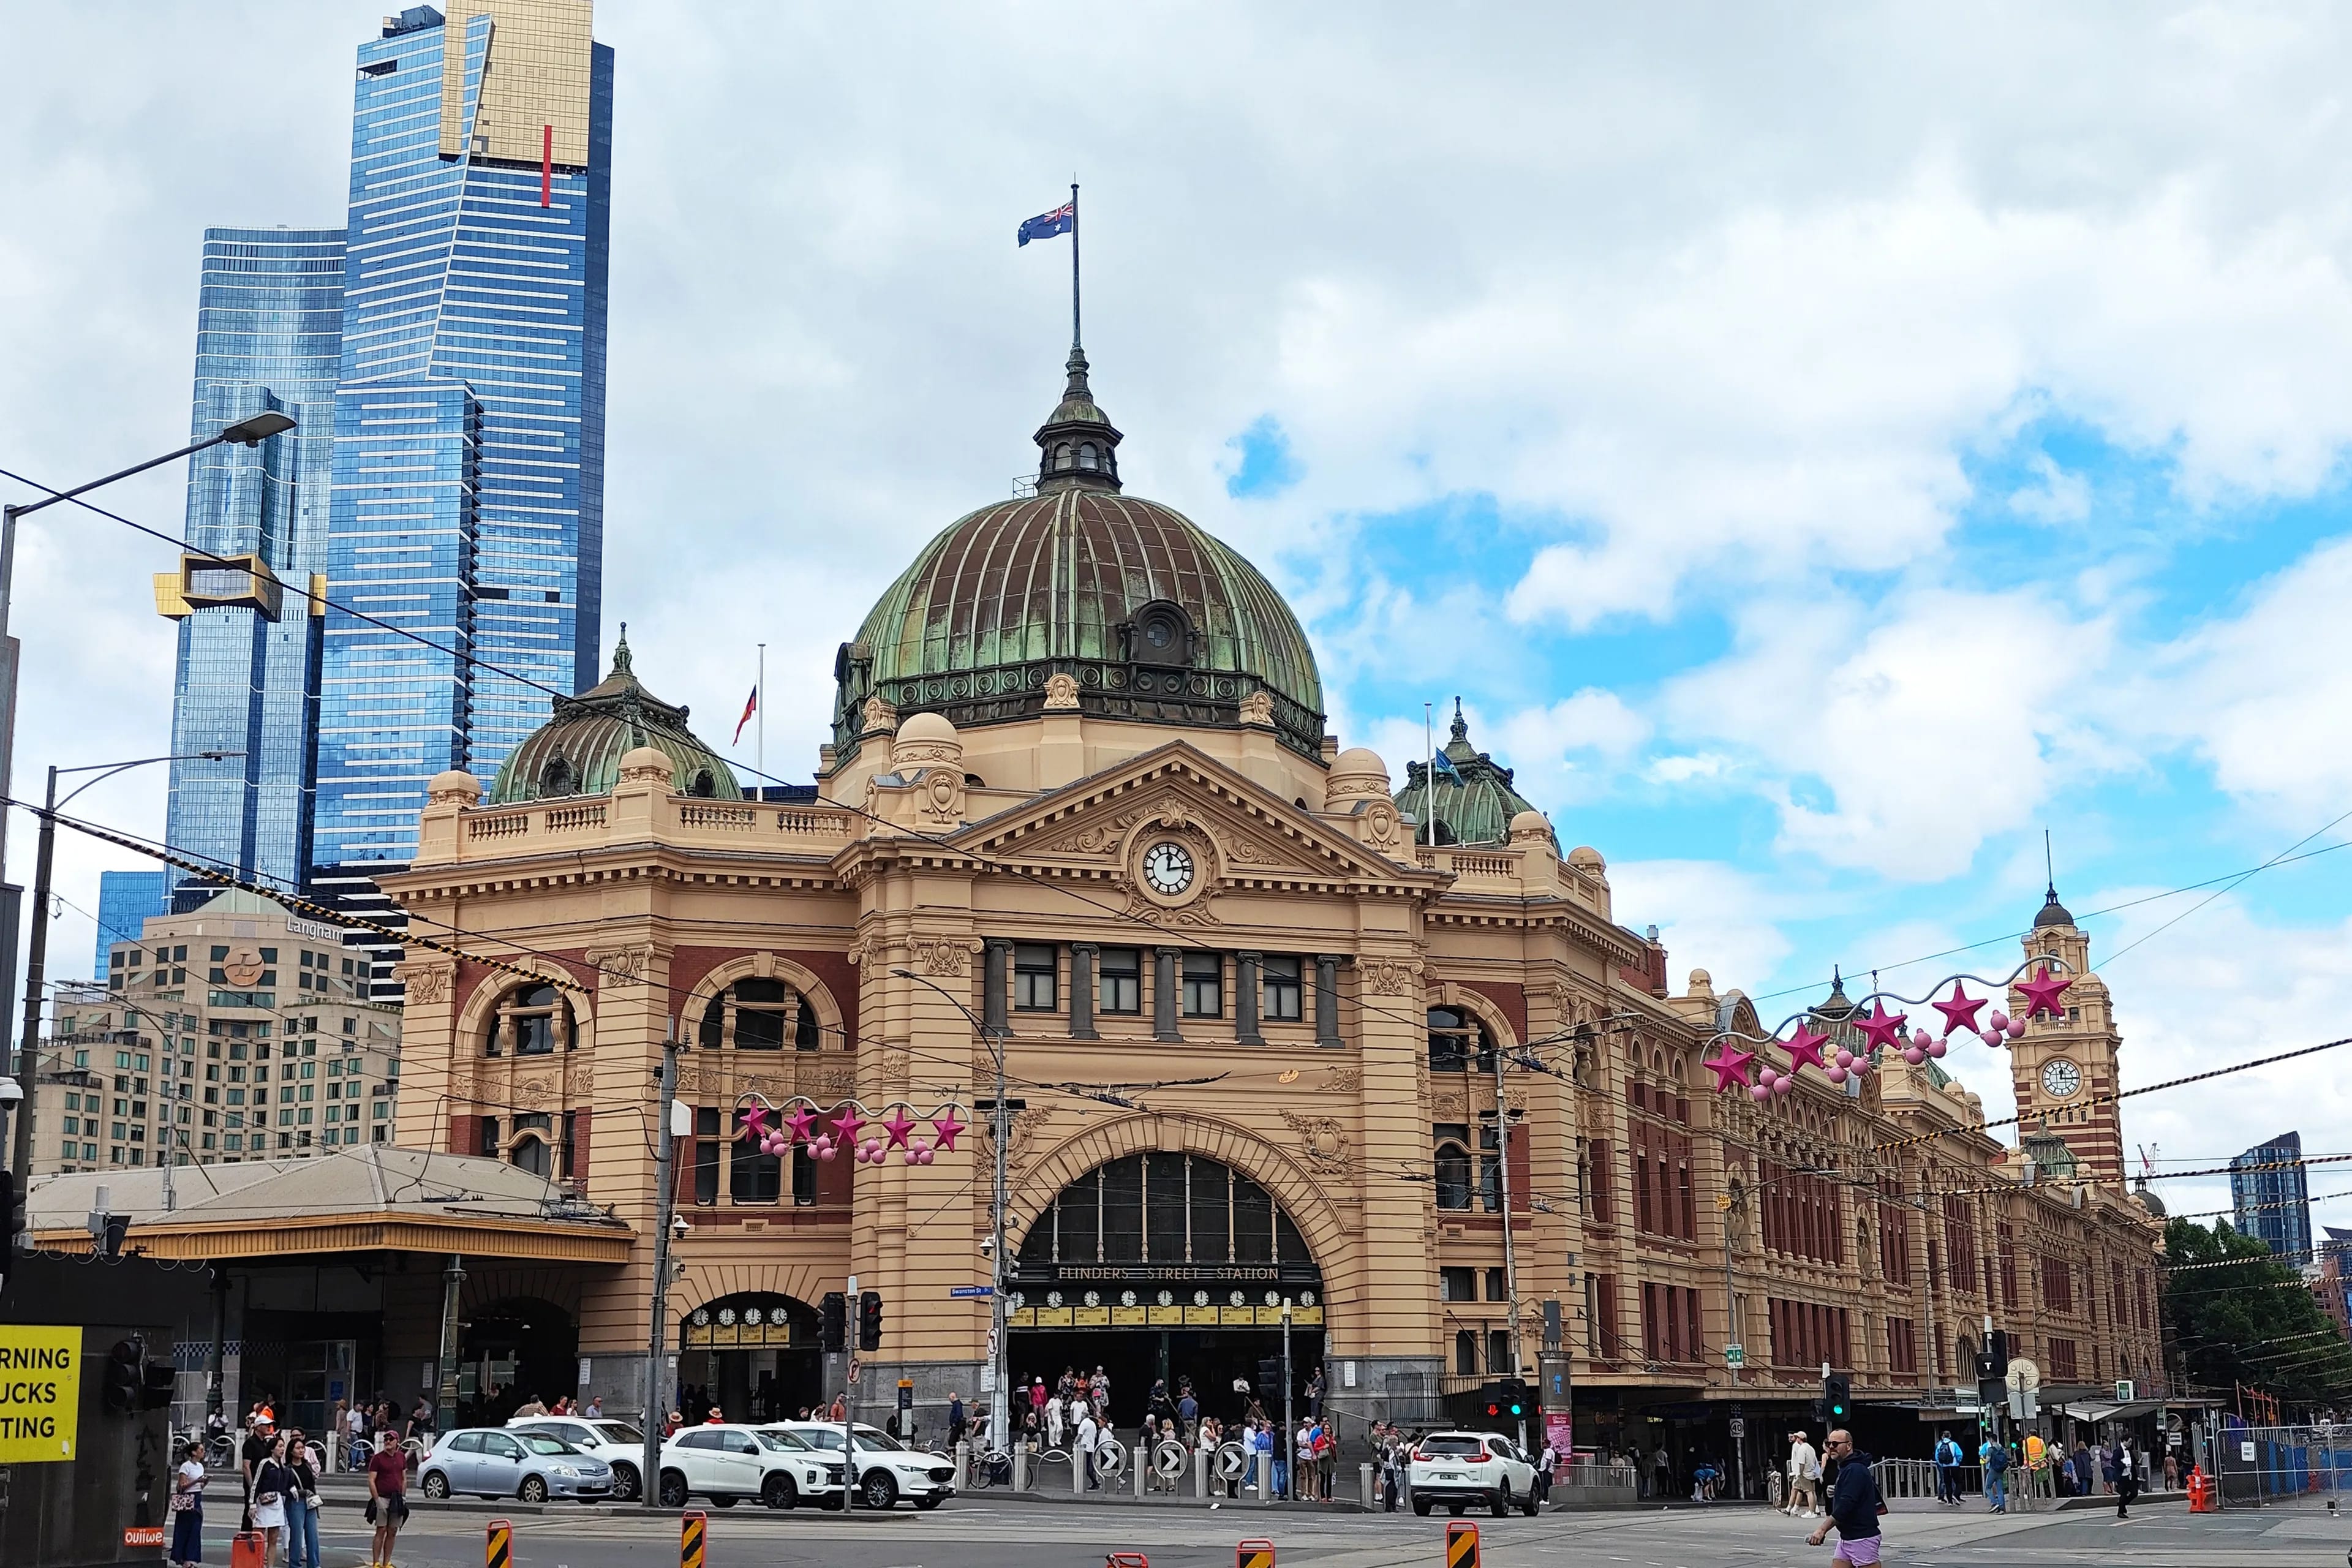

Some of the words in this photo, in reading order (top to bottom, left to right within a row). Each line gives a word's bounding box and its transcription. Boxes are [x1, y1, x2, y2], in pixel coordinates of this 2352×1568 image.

[287, 916, 344, 941] Langham
[1059, 1267, 1129, 1280] FLINDERS
[1147, 1267, 1200, 1280] STREET
[1216, 1267, 1278, 1280] STATION
[0, 1417, 55, 1438] TING
